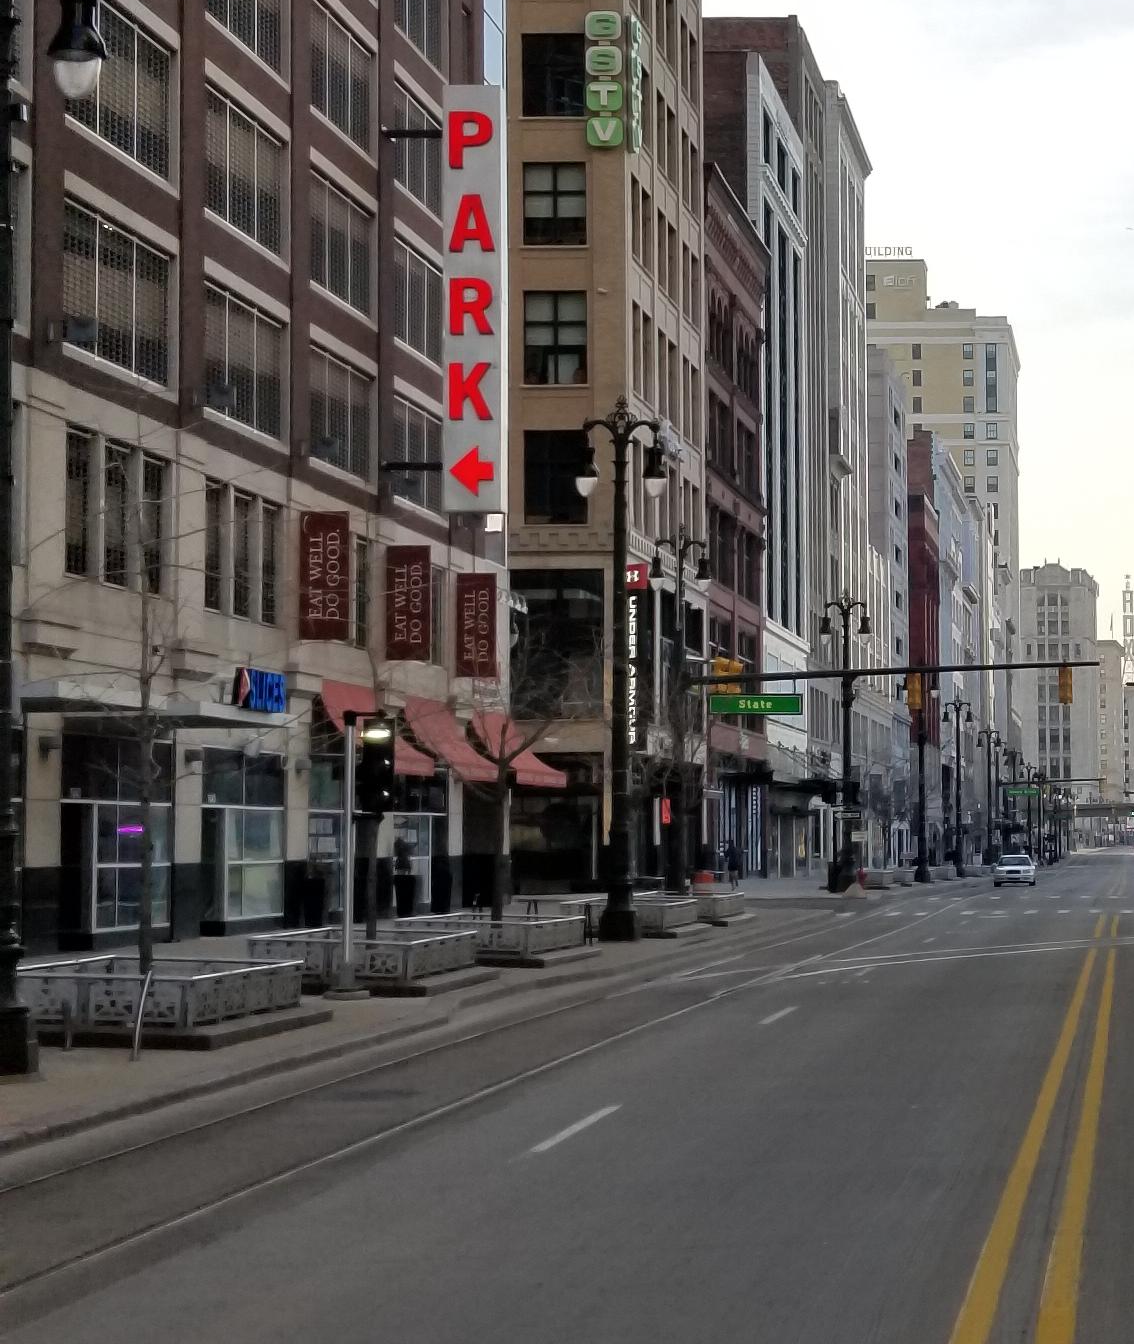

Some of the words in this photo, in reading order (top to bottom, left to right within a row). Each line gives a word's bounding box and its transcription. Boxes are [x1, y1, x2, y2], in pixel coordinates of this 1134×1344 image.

[448, 111, 496, 421] PARK
[309, 532, 323, 581] WELL
[326, 529, 340, 587] GOOD.
[309, 586, 323, 620] EAT
[394, 564, 407, 608] WELL
[326, 593, 340, 620] DO
[464, 590, 476, 631] WELL
[394, 615, 407, 641] EAT
[410, 619, 422, 644] DO
[628, 595, 637, 659] UNDER
[464, 637, 476, 661] EAT
[478, 639, 489, 662] DO
[738, 699, 773, 709] State
